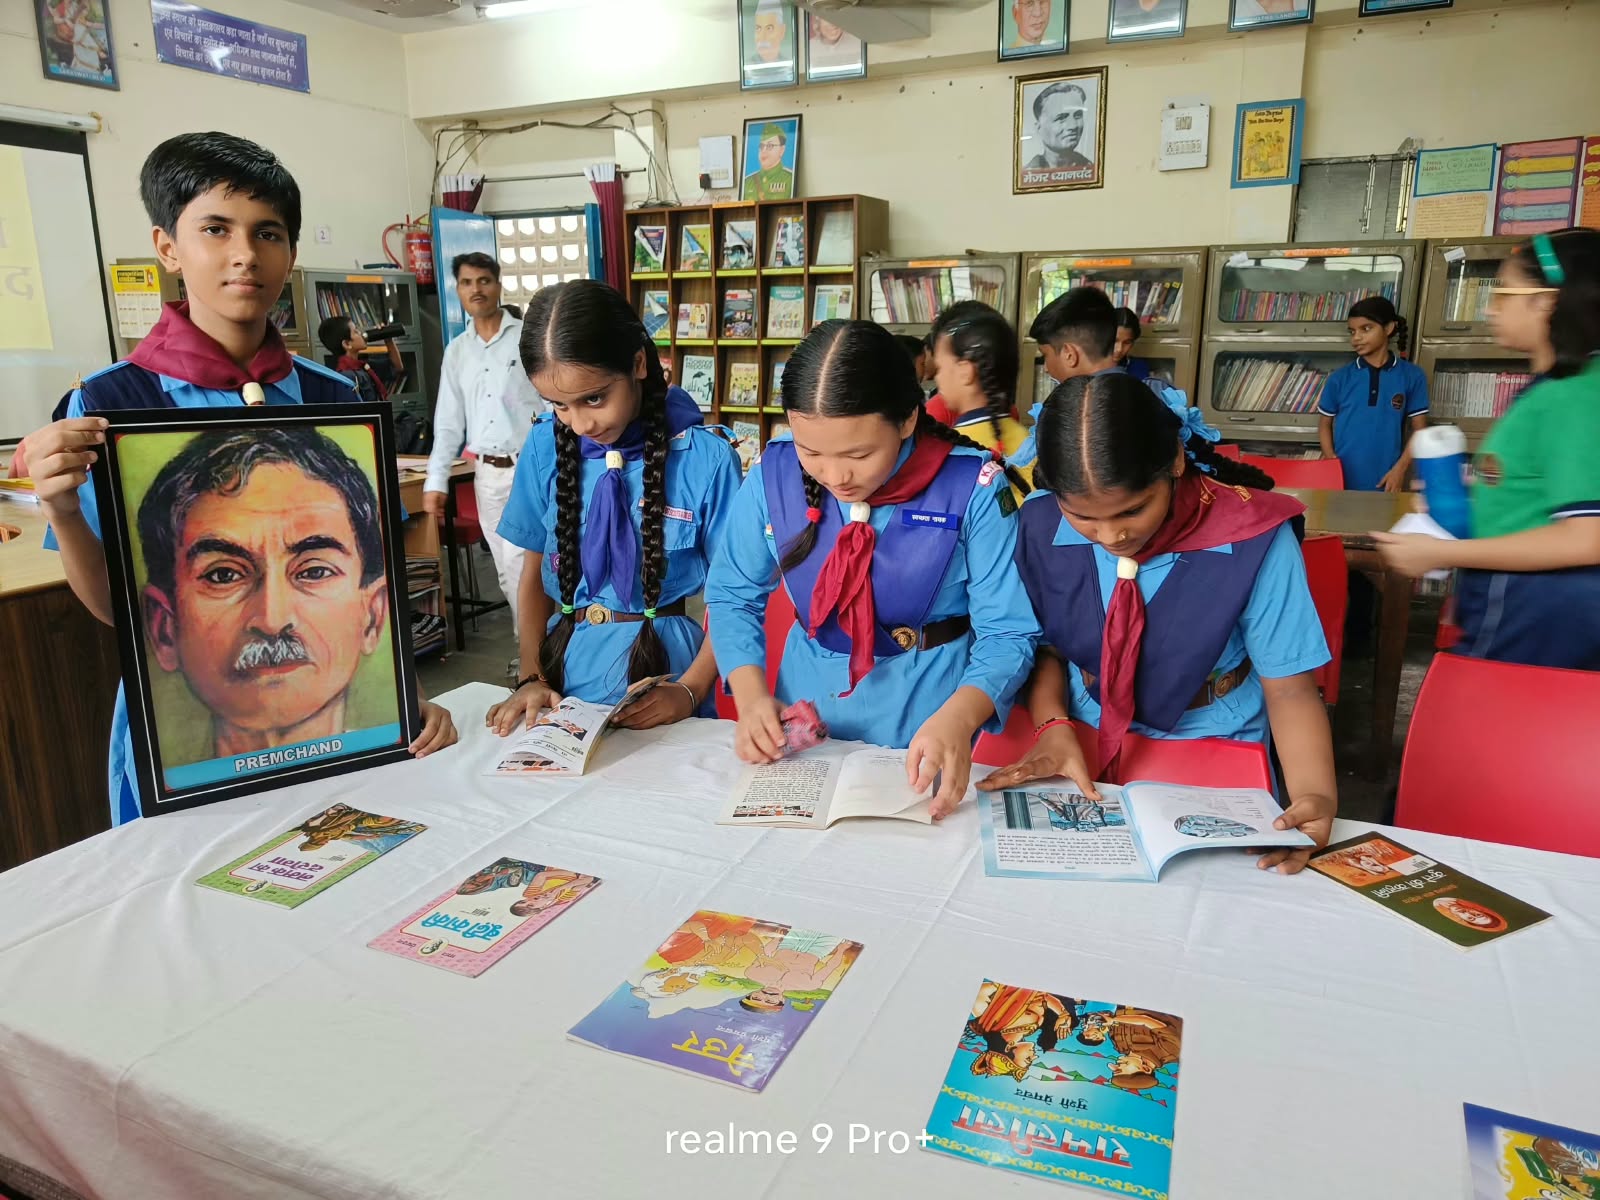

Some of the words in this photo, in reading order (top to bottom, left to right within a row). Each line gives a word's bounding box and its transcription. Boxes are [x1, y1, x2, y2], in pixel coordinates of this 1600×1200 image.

[188, 14, 196, 26] को
[194, 35, 202, 45] का
[195, 52, 203, 63] का
[1023, 170, 1049, 183] मेजर
[1051, 167, 1092, 181] ध्यानचंद
[320, 229, 327, 241] 2
[234, 739, 343, 773] PREMCHAND
[248, 861, 272, 873] का
[267, 856, 325, 873] दरोगा
[271, 866, 315, 882] नमक
[1370, 883, 1409, 899] कहानी
[1404, 877, 1424, 889] की
[420, 911, 468, 933] काकी
[462, 921, 504, 941] बूढ़ी
[671, 1030, 757, 1078] नेउर
[1014, 1088, 1054, 1106] प्रेमचंद
[1059, 1097, 1089, 1112] मुंशी
[950, 1103, 1133, 1169] रामलीला
